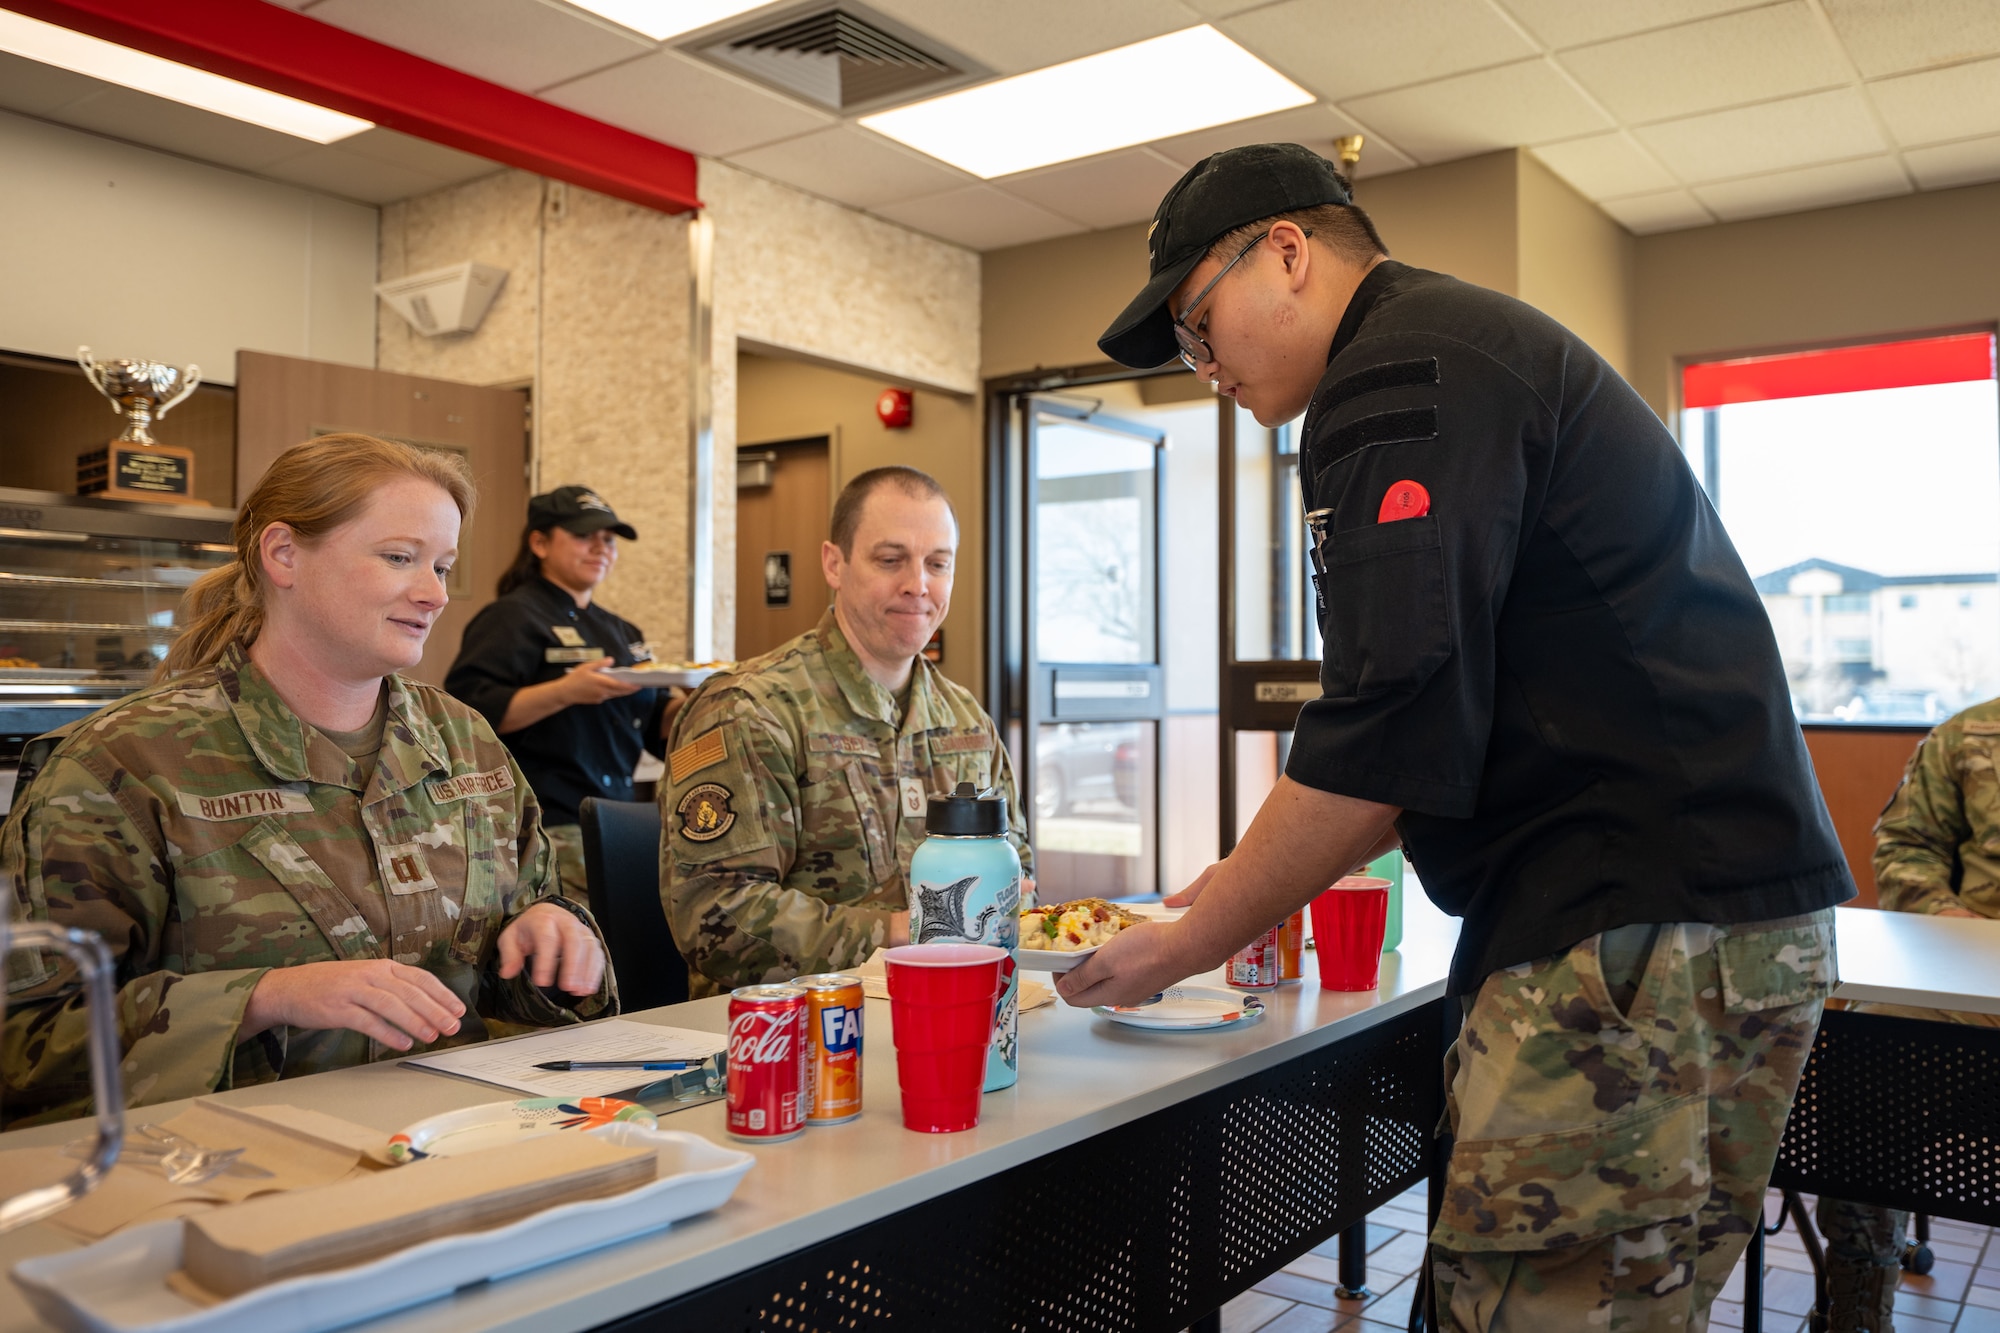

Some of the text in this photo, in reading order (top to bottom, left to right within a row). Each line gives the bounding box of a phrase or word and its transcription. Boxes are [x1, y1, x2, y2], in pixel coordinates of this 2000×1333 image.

[432, 783, 458, 800] U.S.
[457, 776, 477, 796] AIR
[199, 791, 284, 818] BUNTYN
[808, 1041, 817, 1059] ME
[731, 1062, 753, 1073] TASTE
[806, 1060, 816, 1114] RECYCLE
